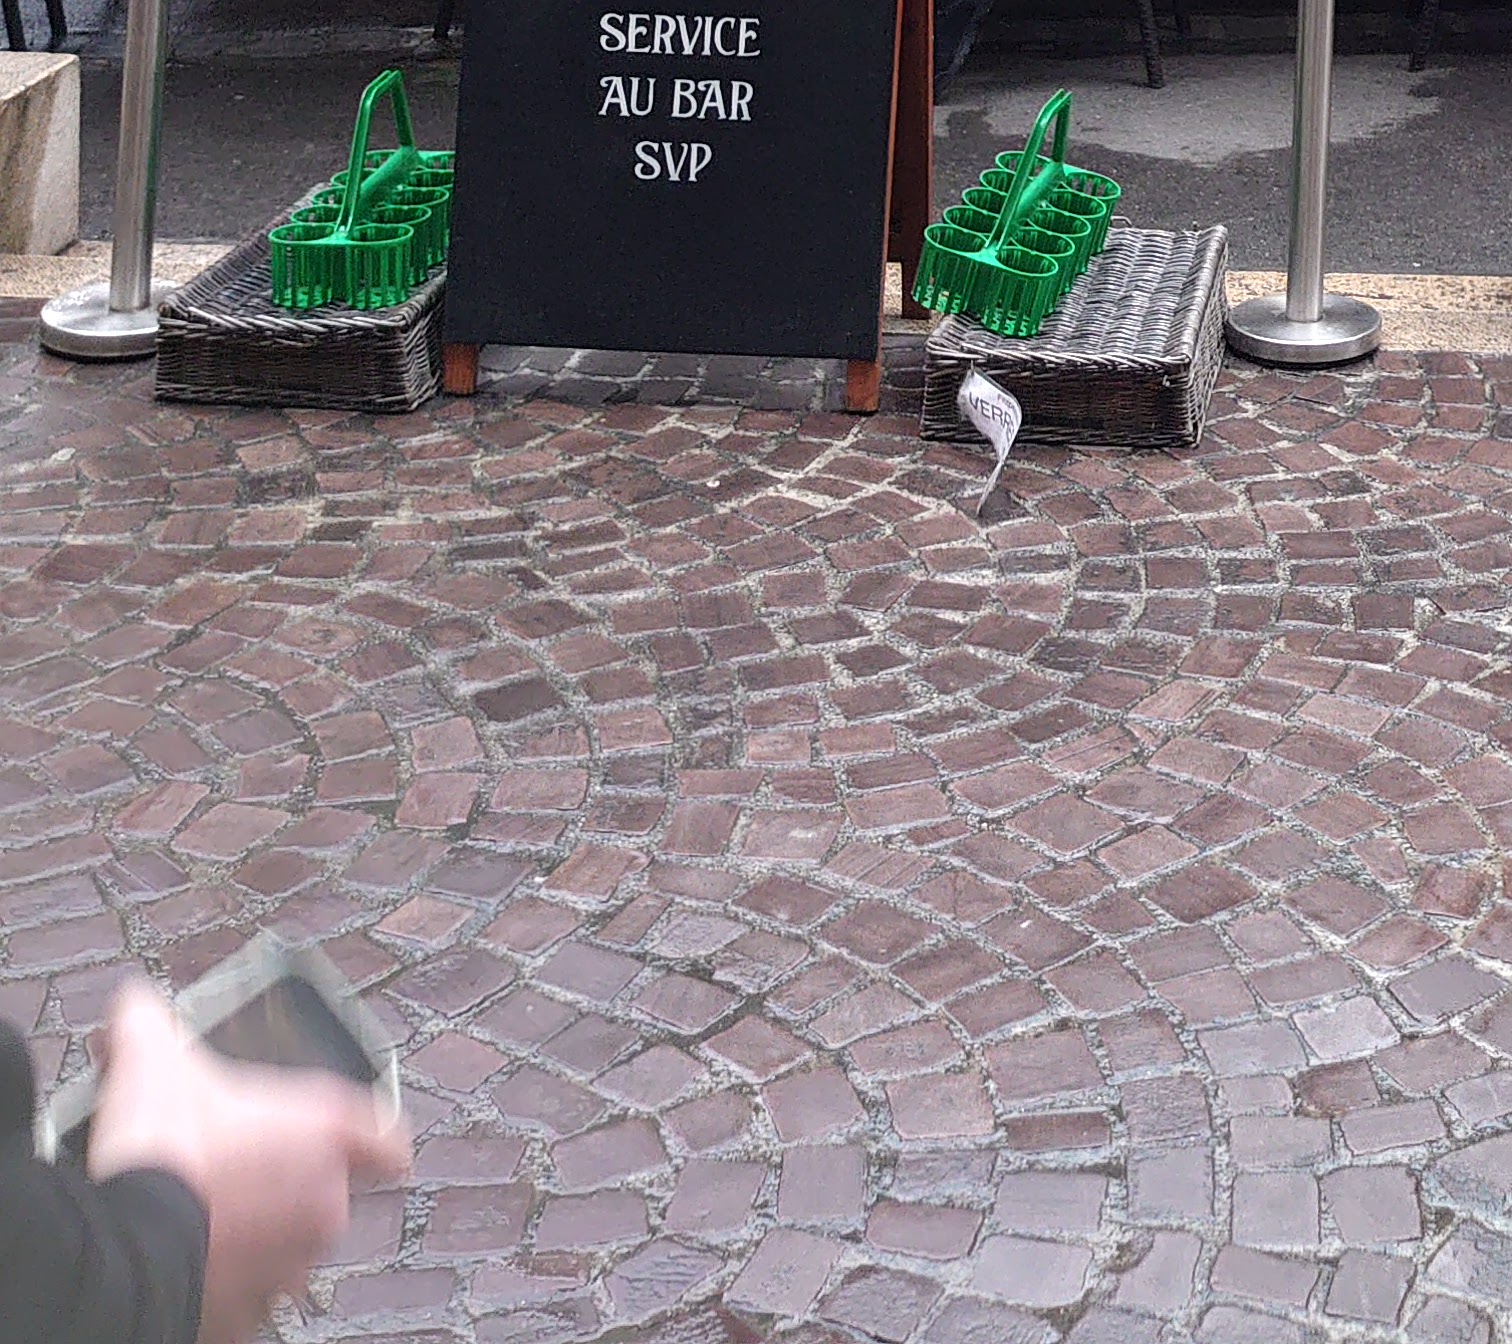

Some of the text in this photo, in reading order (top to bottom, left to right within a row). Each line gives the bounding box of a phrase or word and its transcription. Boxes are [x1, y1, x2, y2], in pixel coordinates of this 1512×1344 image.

[599, 12, 761, 57] SERVICE
[598, 76, 754, 121] AU BAR
[634, 140, 713, 182] SVP
